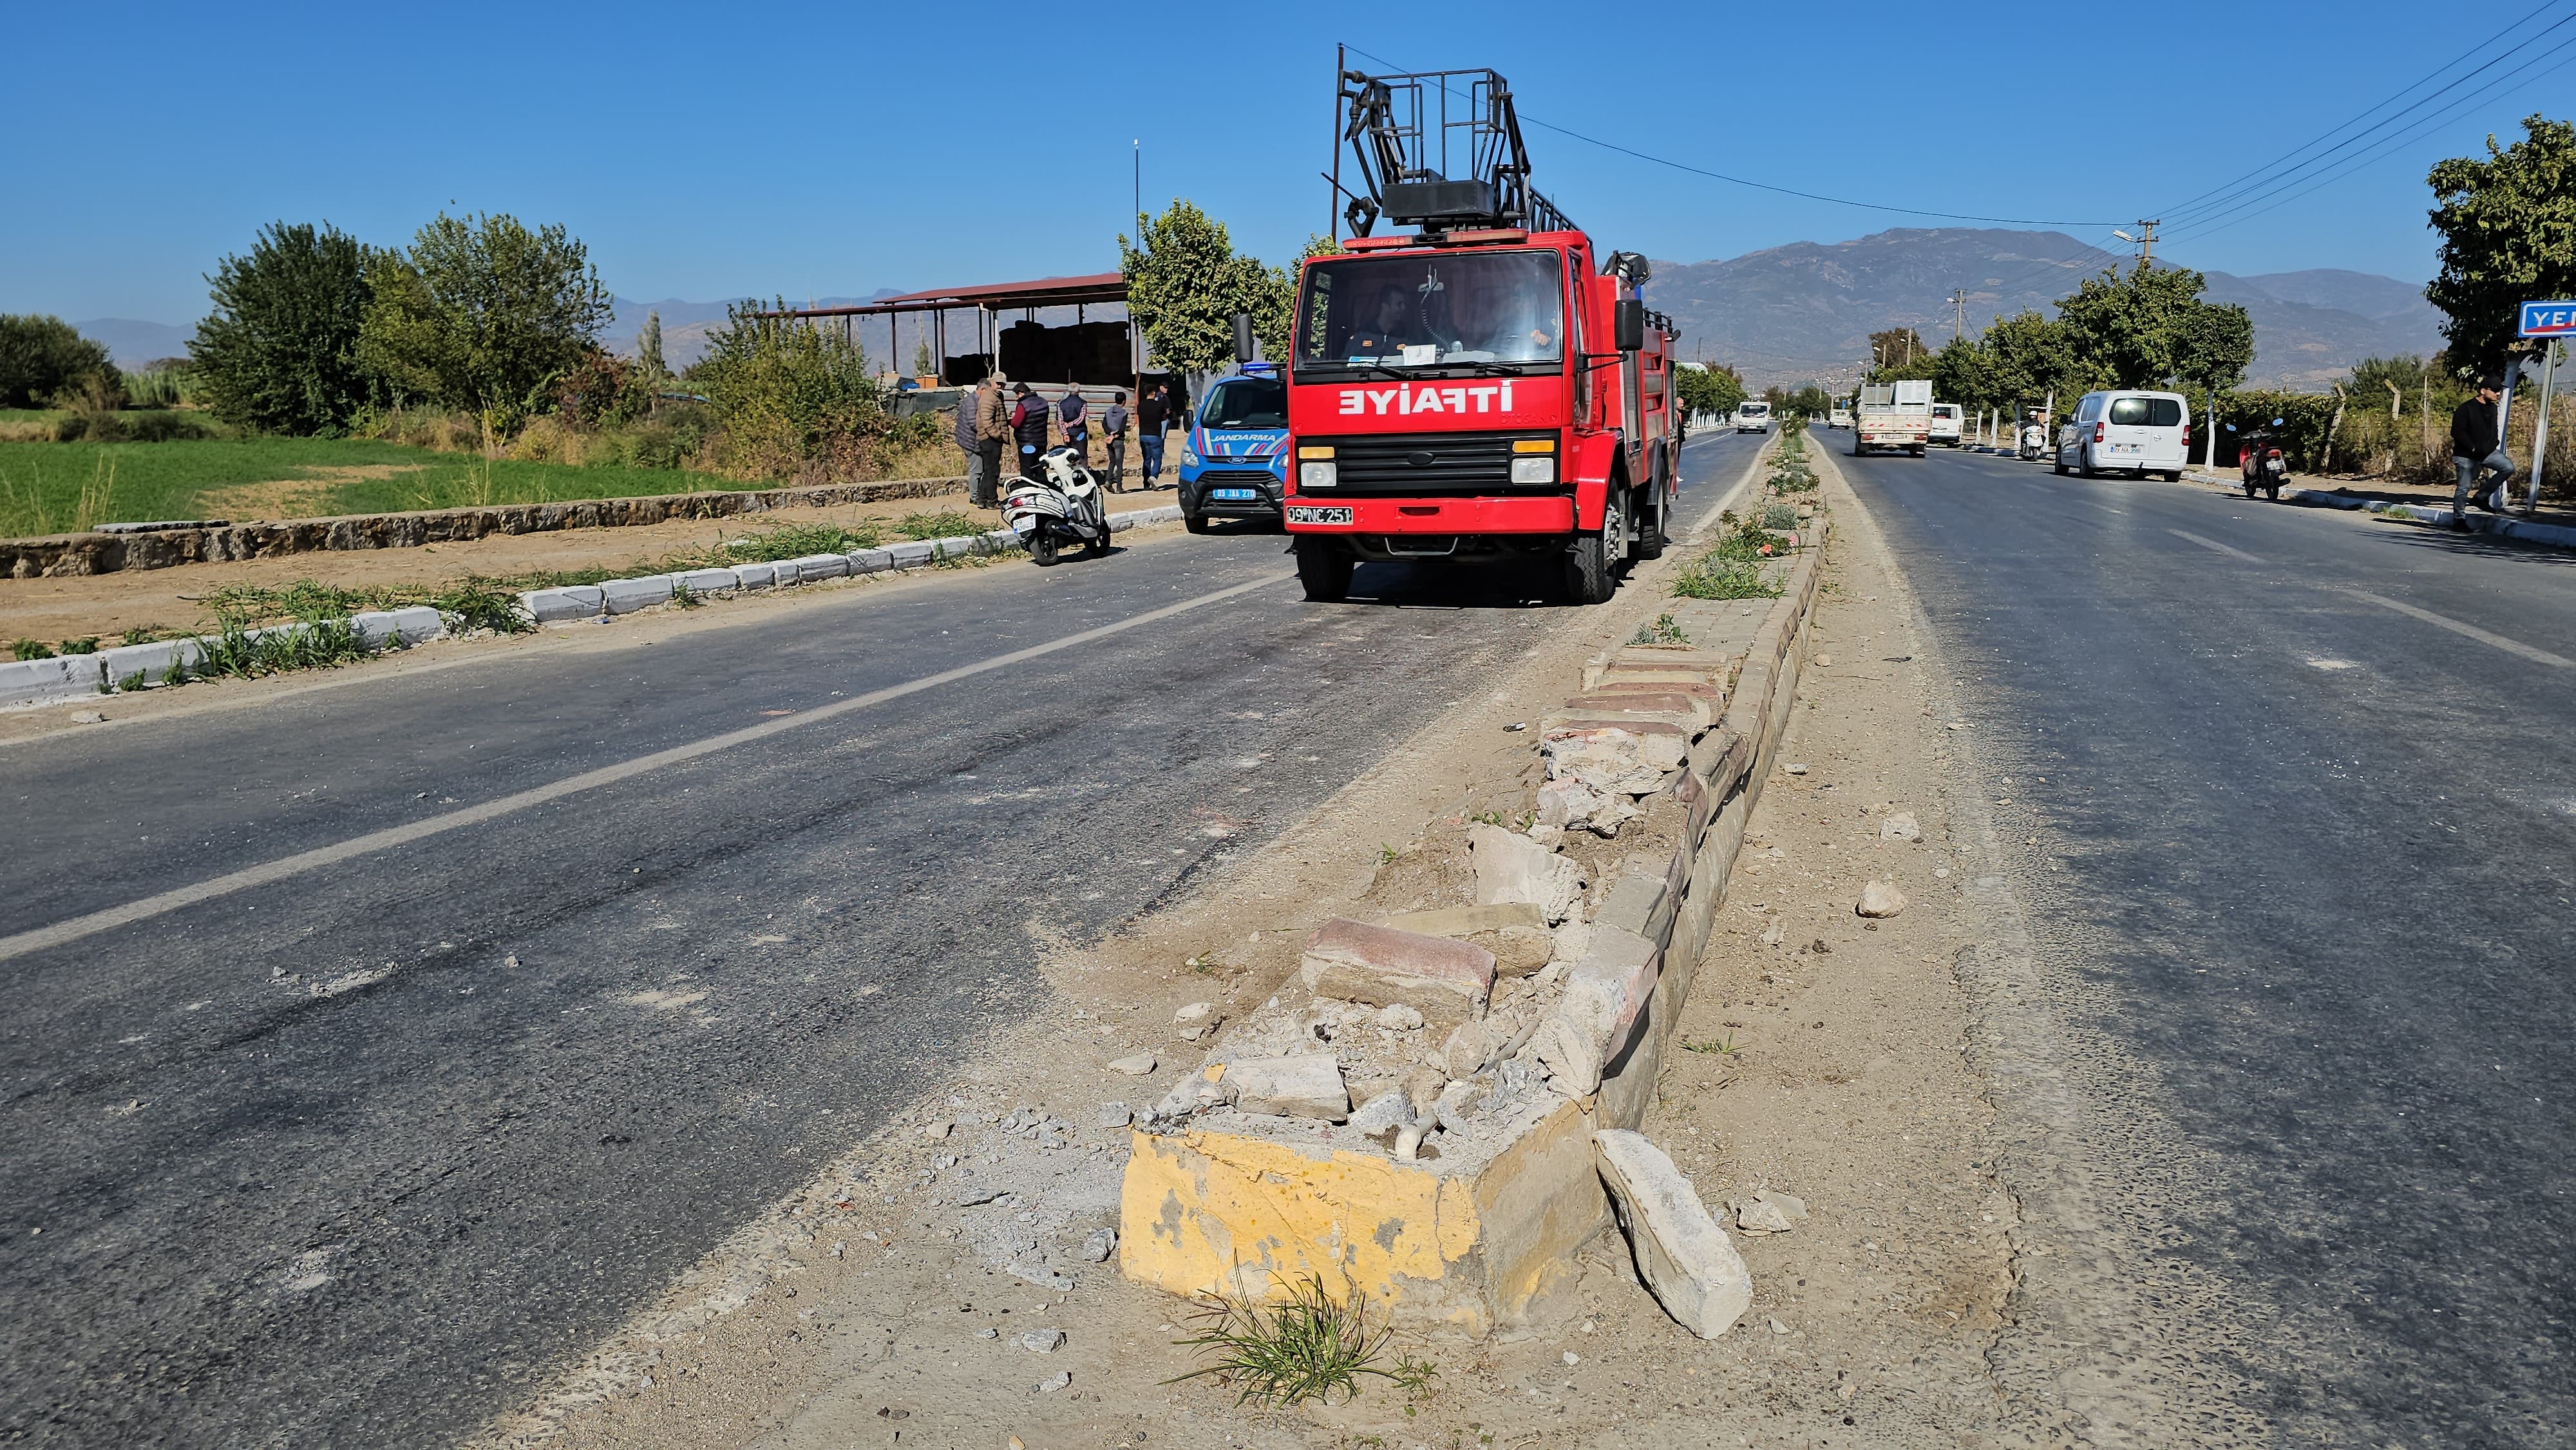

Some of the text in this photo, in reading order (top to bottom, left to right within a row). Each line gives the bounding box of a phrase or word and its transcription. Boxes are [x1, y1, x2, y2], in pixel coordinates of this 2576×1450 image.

[1211, 434, 1276, 442] JANDARMA
[1288, 507, 1350, 523] 09 NC 251
